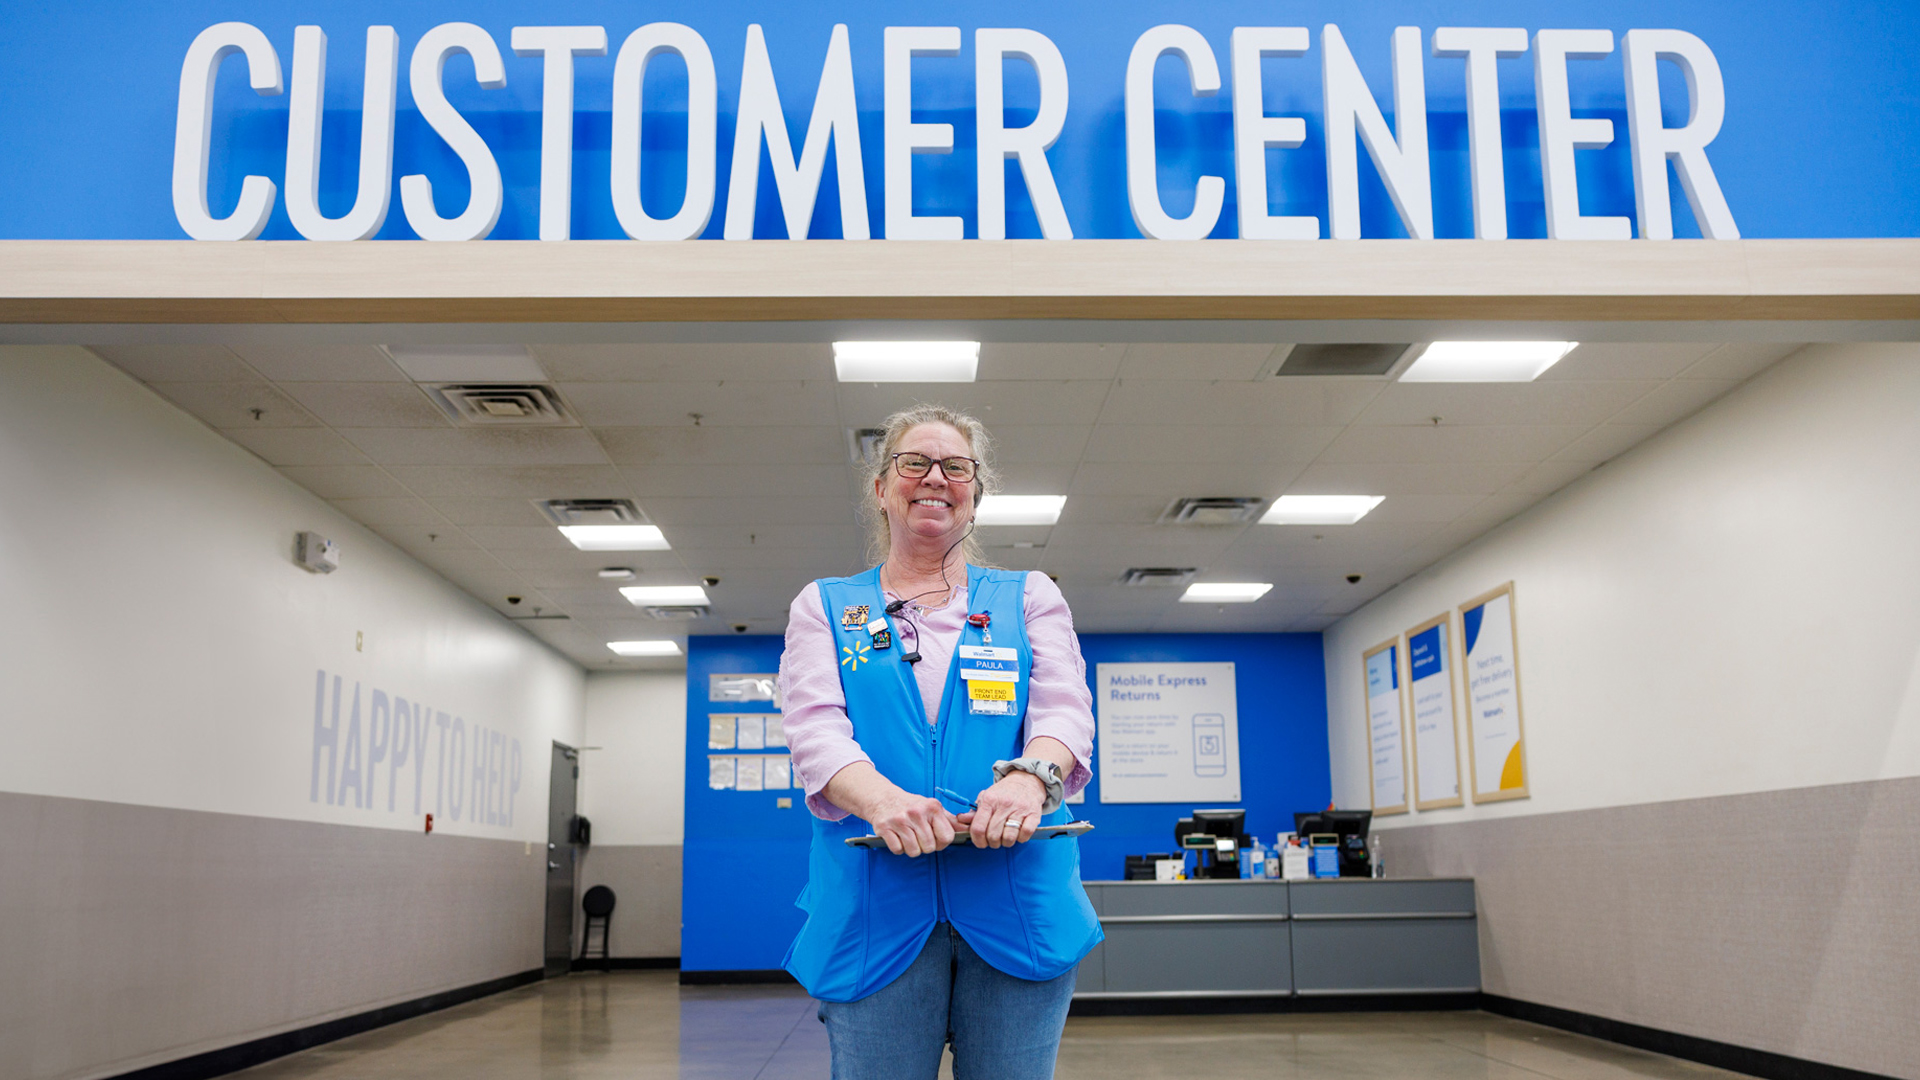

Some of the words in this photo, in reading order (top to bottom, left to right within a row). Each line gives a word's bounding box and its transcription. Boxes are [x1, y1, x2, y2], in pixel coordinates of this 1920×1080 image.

[172, 21, 1074, 241] CUSTOMER
[1124, 23, 1740, 240] CENTER
[976, 660, 1004, 670] PAULA
[1477, 659, 1489, 669] Next
[1110, 675, 1154, 686] Mobile
[1158, 674, 1207, 688] Express
[1480, 674, 1490, 684] free
[1492, 669, 1512, 682] delivery
[1110, 689, 1160, 700] Returns
[310, 669, 431, 816] HAPPY
[436, 710, 466, 821] TO
[470, 724, 522, 827] HELP
